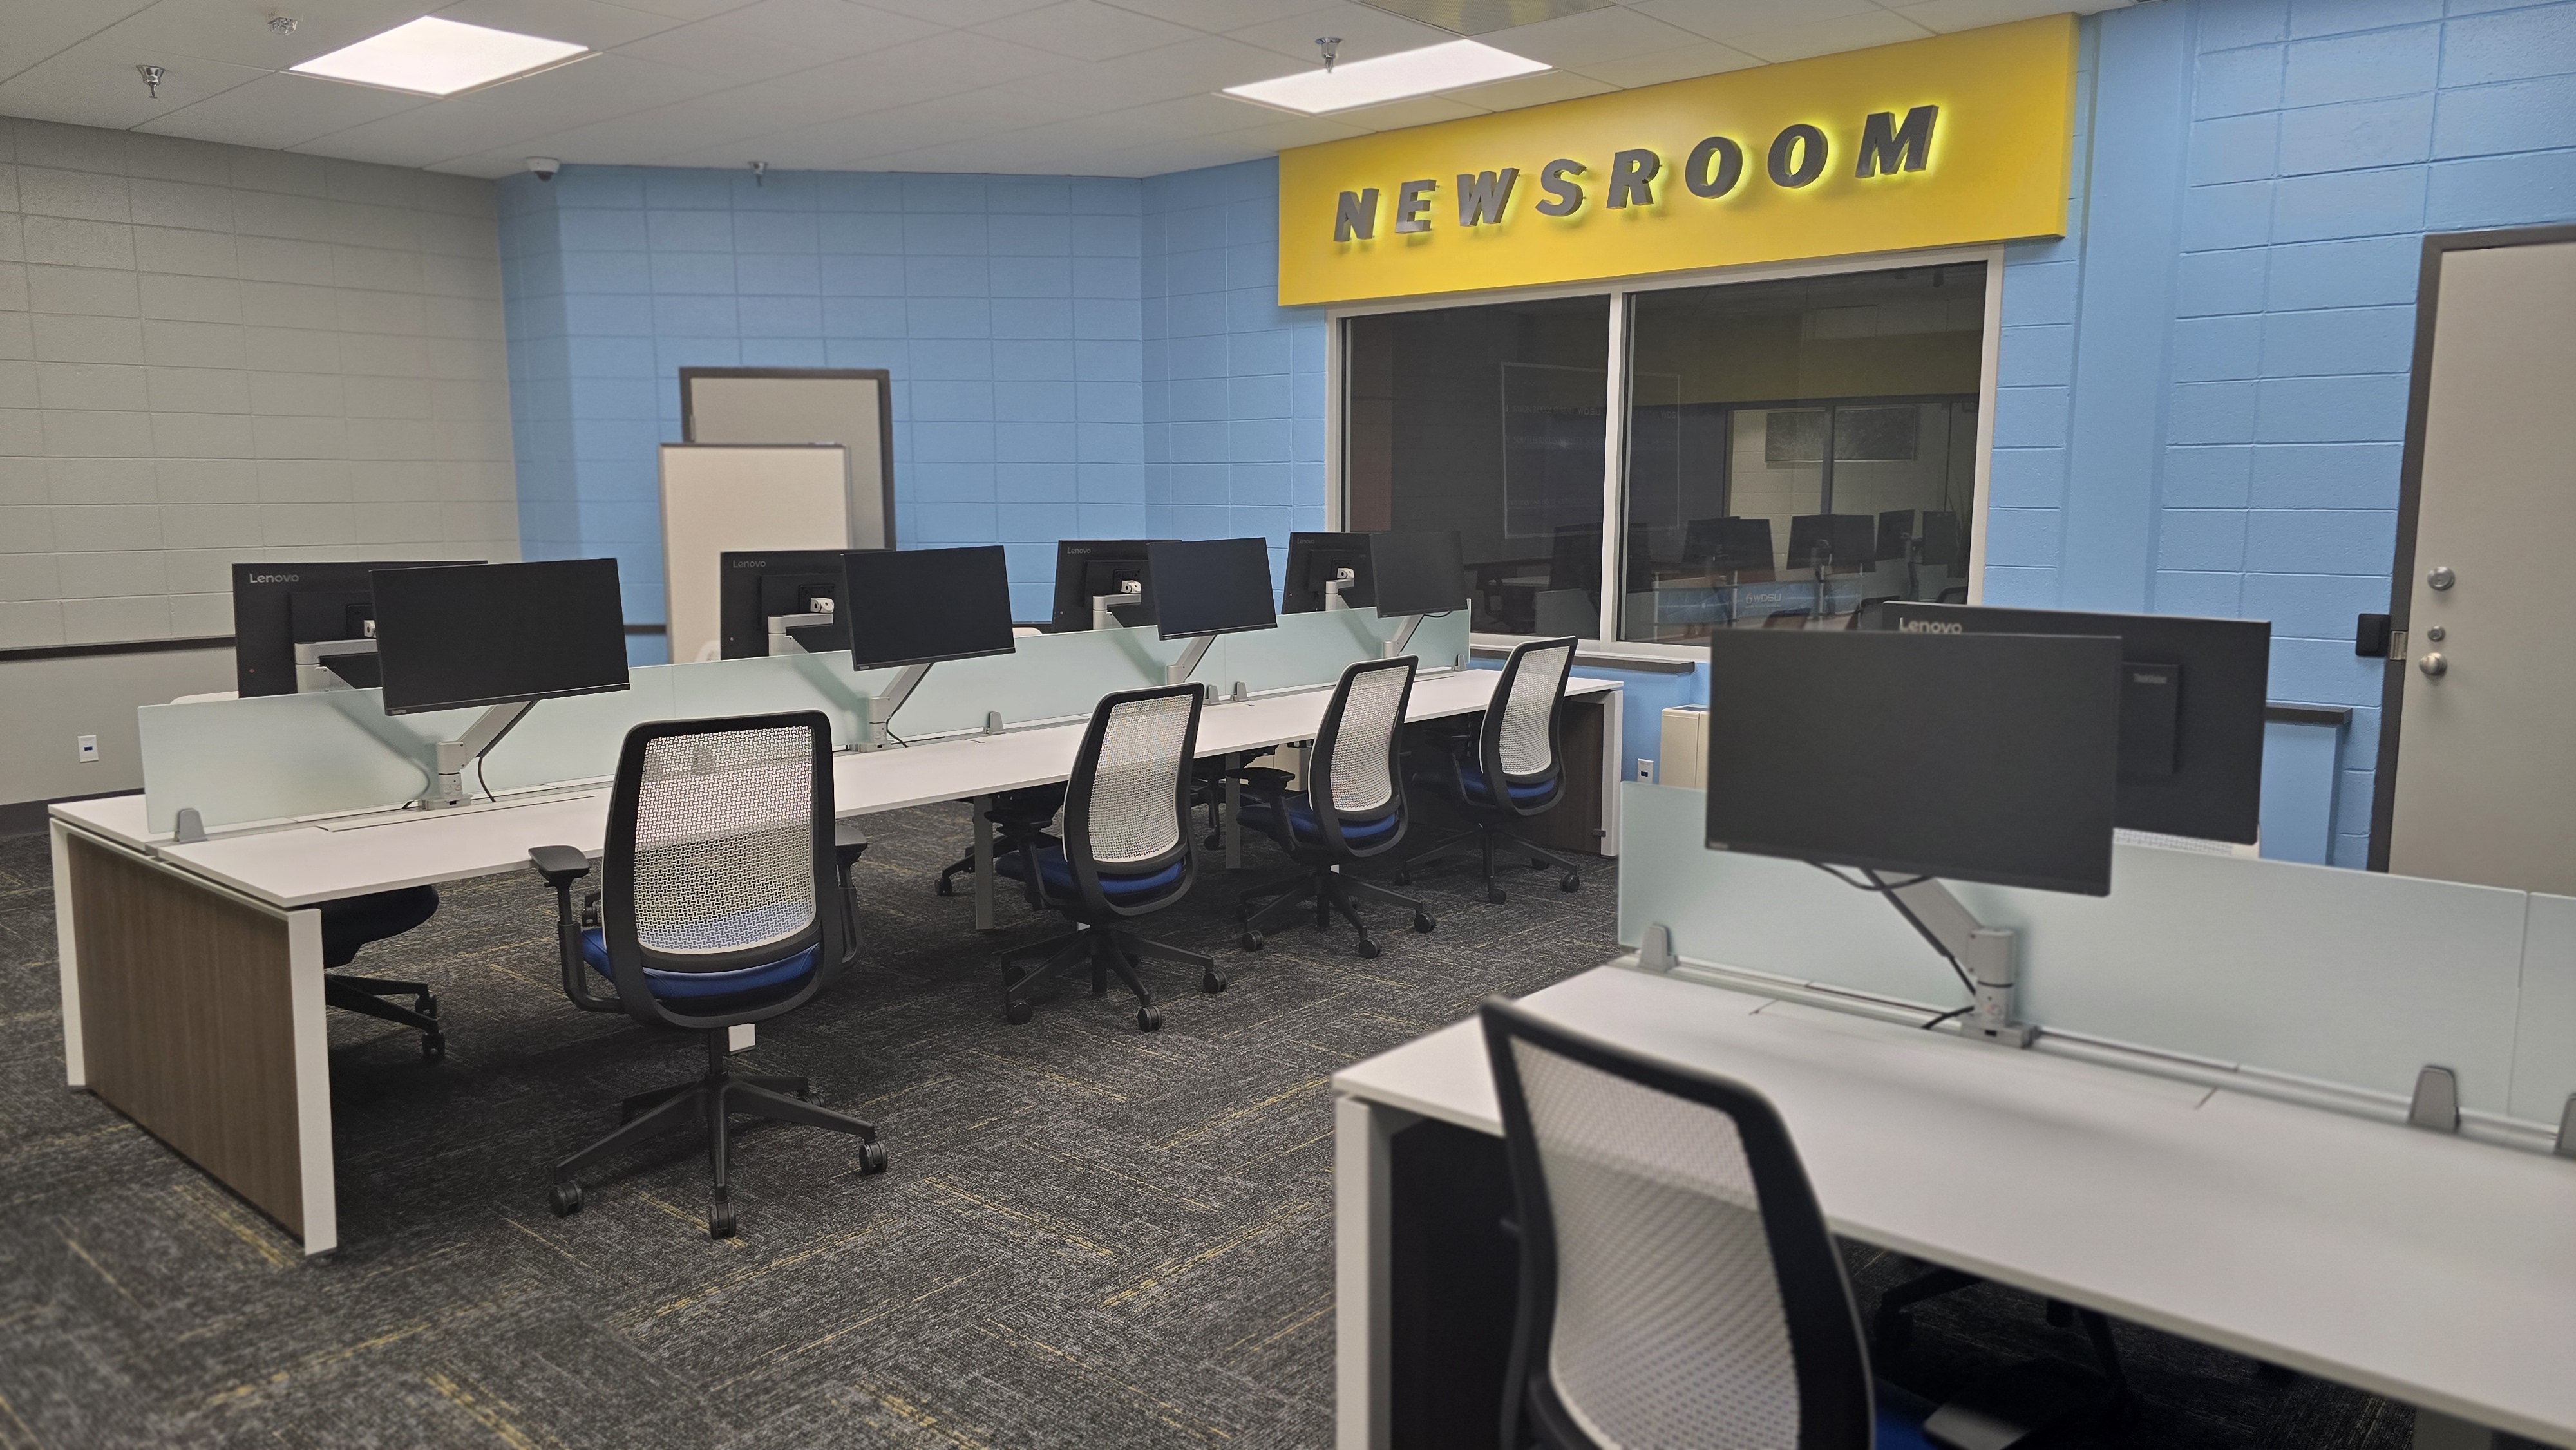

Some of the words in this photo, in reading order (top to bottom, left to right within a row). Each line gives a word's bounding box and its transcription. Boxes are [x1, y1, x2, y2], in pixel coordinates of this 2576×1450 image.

[1333, 105, 1939, 242] NEWSROOM
[249, 573, 299, 583] Lenovo
[1899, 617, 1962, 634] Lenovo
